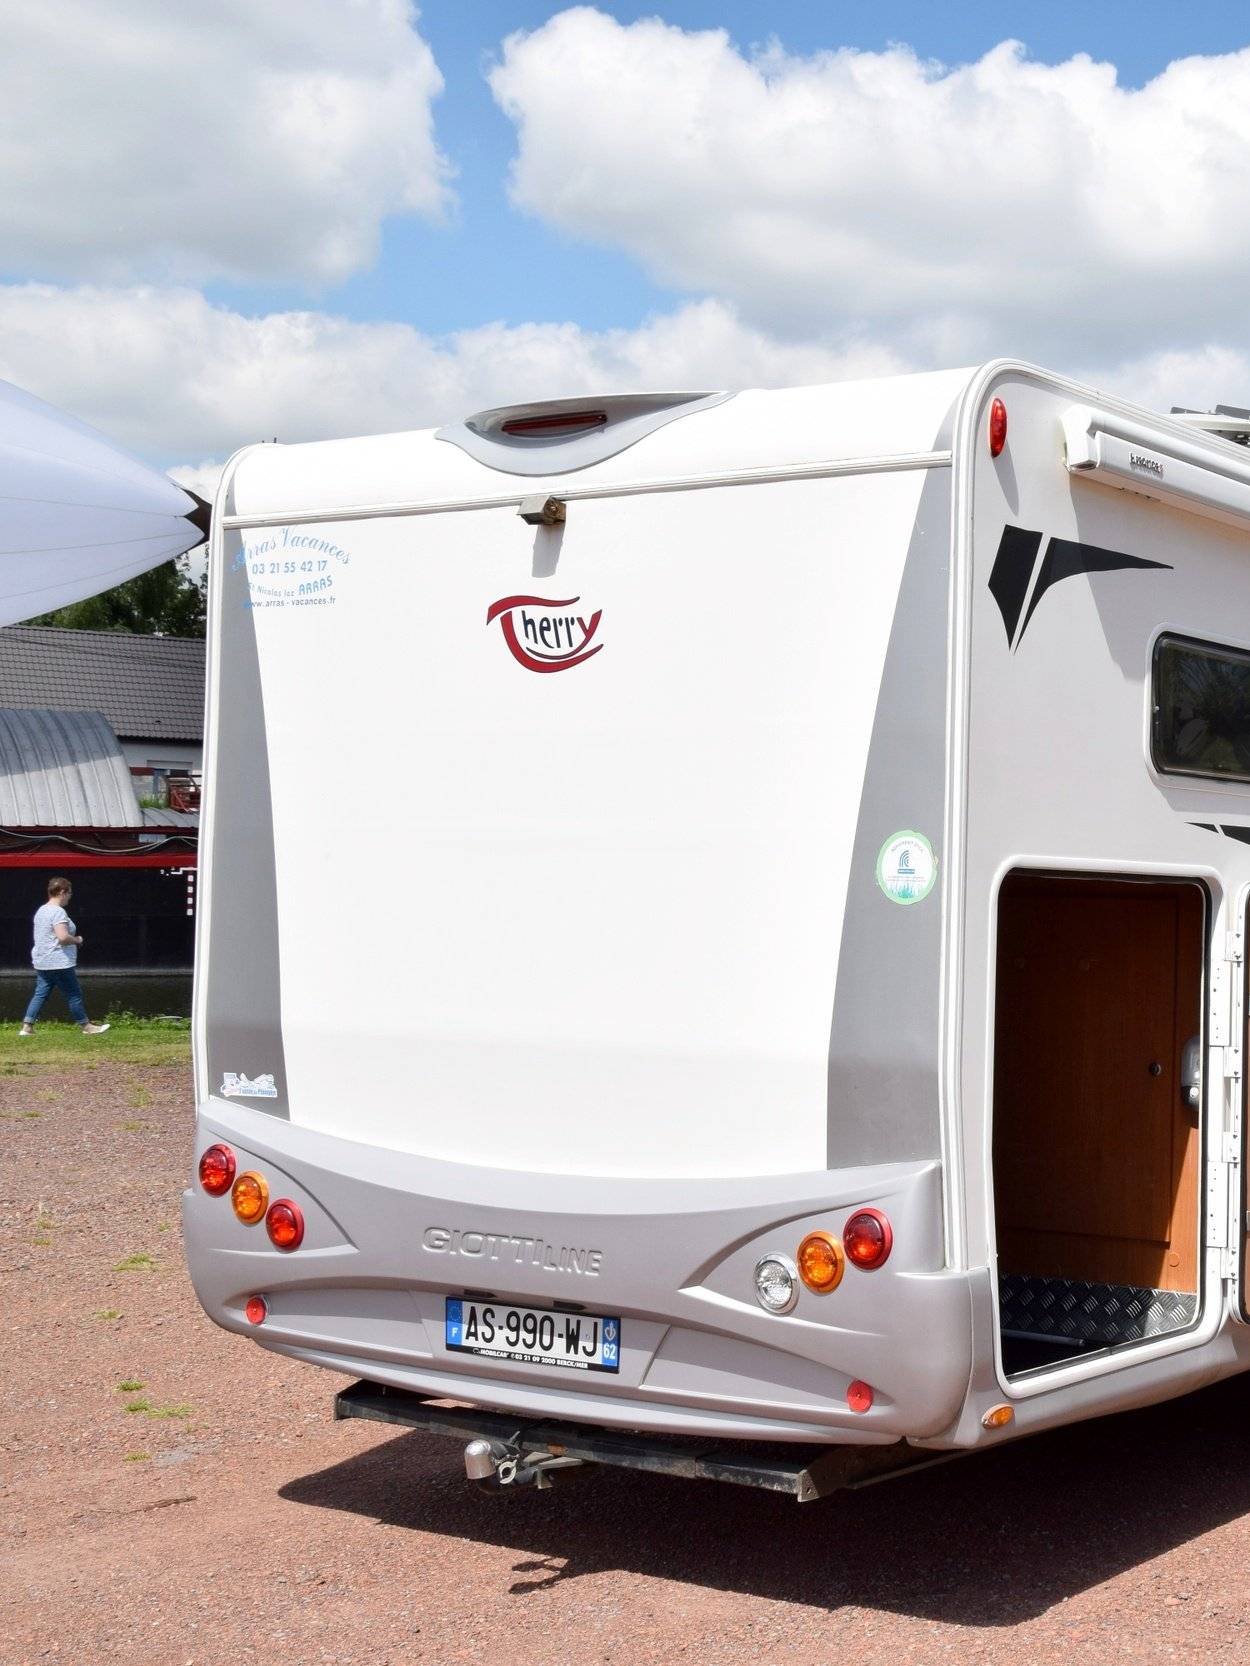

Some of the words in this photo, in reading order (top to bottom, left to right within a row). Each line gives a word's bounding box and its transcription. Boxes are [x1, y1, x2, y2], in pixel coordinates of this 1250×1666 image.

[282, 526, 352, 565] Vacances
[252, 563, 265, 575] 03
[270, 562, 280, 574] 21
[284, 561, 296, 573] 55
[300, 560, 313, 572] 42
[317, 560, 328, 571] 17
[298, 574, 333, 596] ARRAS
[451, 1327, 458, 1338] F
[465, 1305, 599, 1358] AS-990-WJ
[603, 1343, 616, 1360] 62
[541, 1357, 556, 1366] 2000
